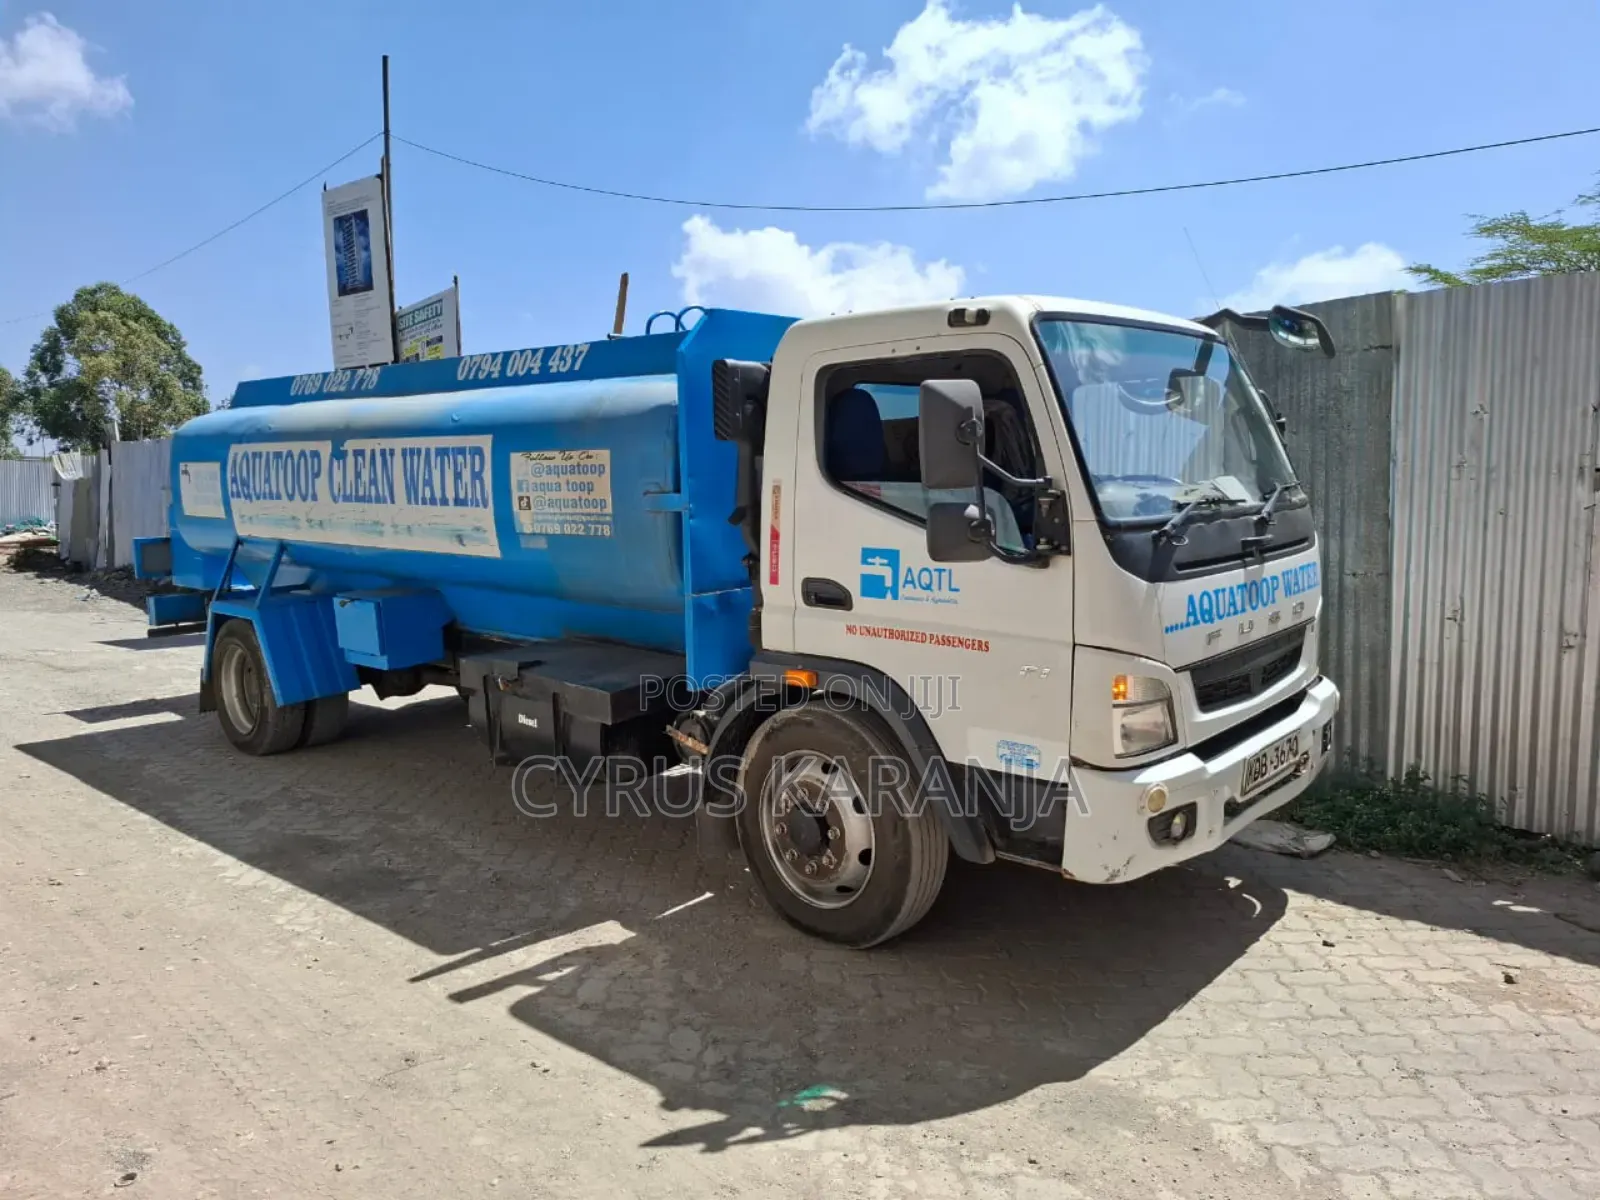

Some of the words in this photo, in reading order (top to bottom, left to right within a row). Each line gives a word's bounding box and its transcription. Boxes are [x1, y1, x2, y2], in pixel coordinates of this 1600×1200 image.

[457, 352, 501, 380] 0794
[506, 348, 542, 377] 004
[548, 343, 590, 373] 437
[230, 449, 321, 503] AQUATOOP
[328, 448, 396, 505] CLEAN
[403, 446, 489, 509] WATER
[530, 462, 606, 478] @aquatoop
[531, 481, 562, 495] aqua
[566, 479, 594, 495] toop
[533, 495, 607, 512] @aquatoop
[588, 524, 611, 536] 778
[902, 566, 960, 592] AQTL
[1282, 562, 1320, 599] WATER
[845, 624, 858, 636] NO
[859, 626, 927, 643] UNAUTHORIZED
[929, 633, 990, 652] PASSENGERS
[518, 714, 538, 728] Diesel
